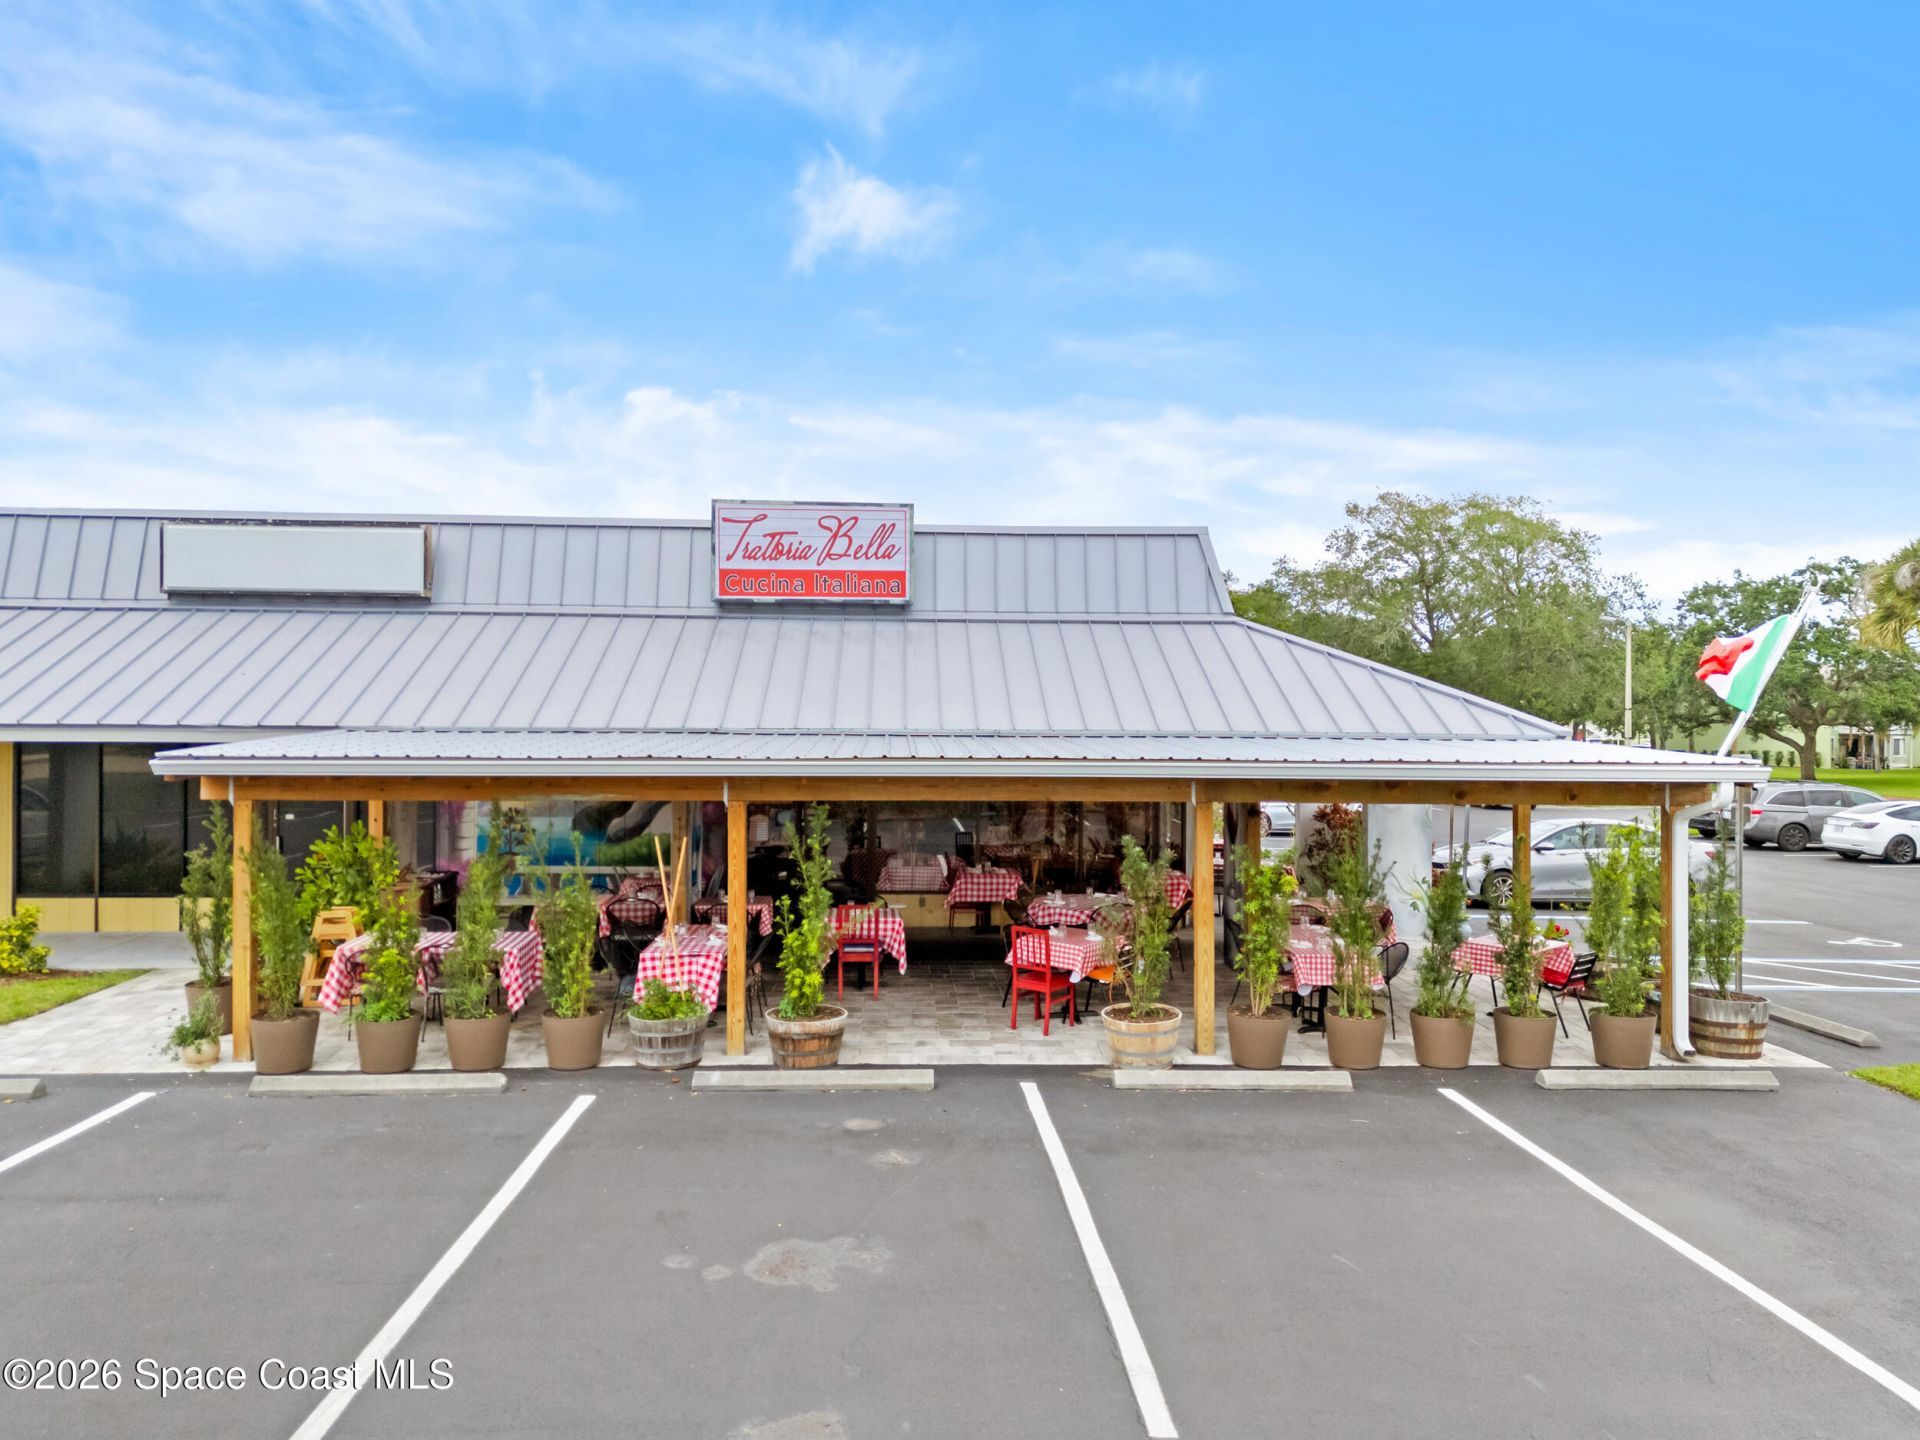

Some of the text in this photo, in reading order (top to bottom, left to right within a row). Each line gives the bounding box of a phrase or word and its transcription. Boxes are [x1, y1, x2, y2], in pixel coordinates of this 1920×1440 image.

[721, 513, 902, 567] Trattoria Bella
[725, 573, 901, 594] Cucina Italiana
